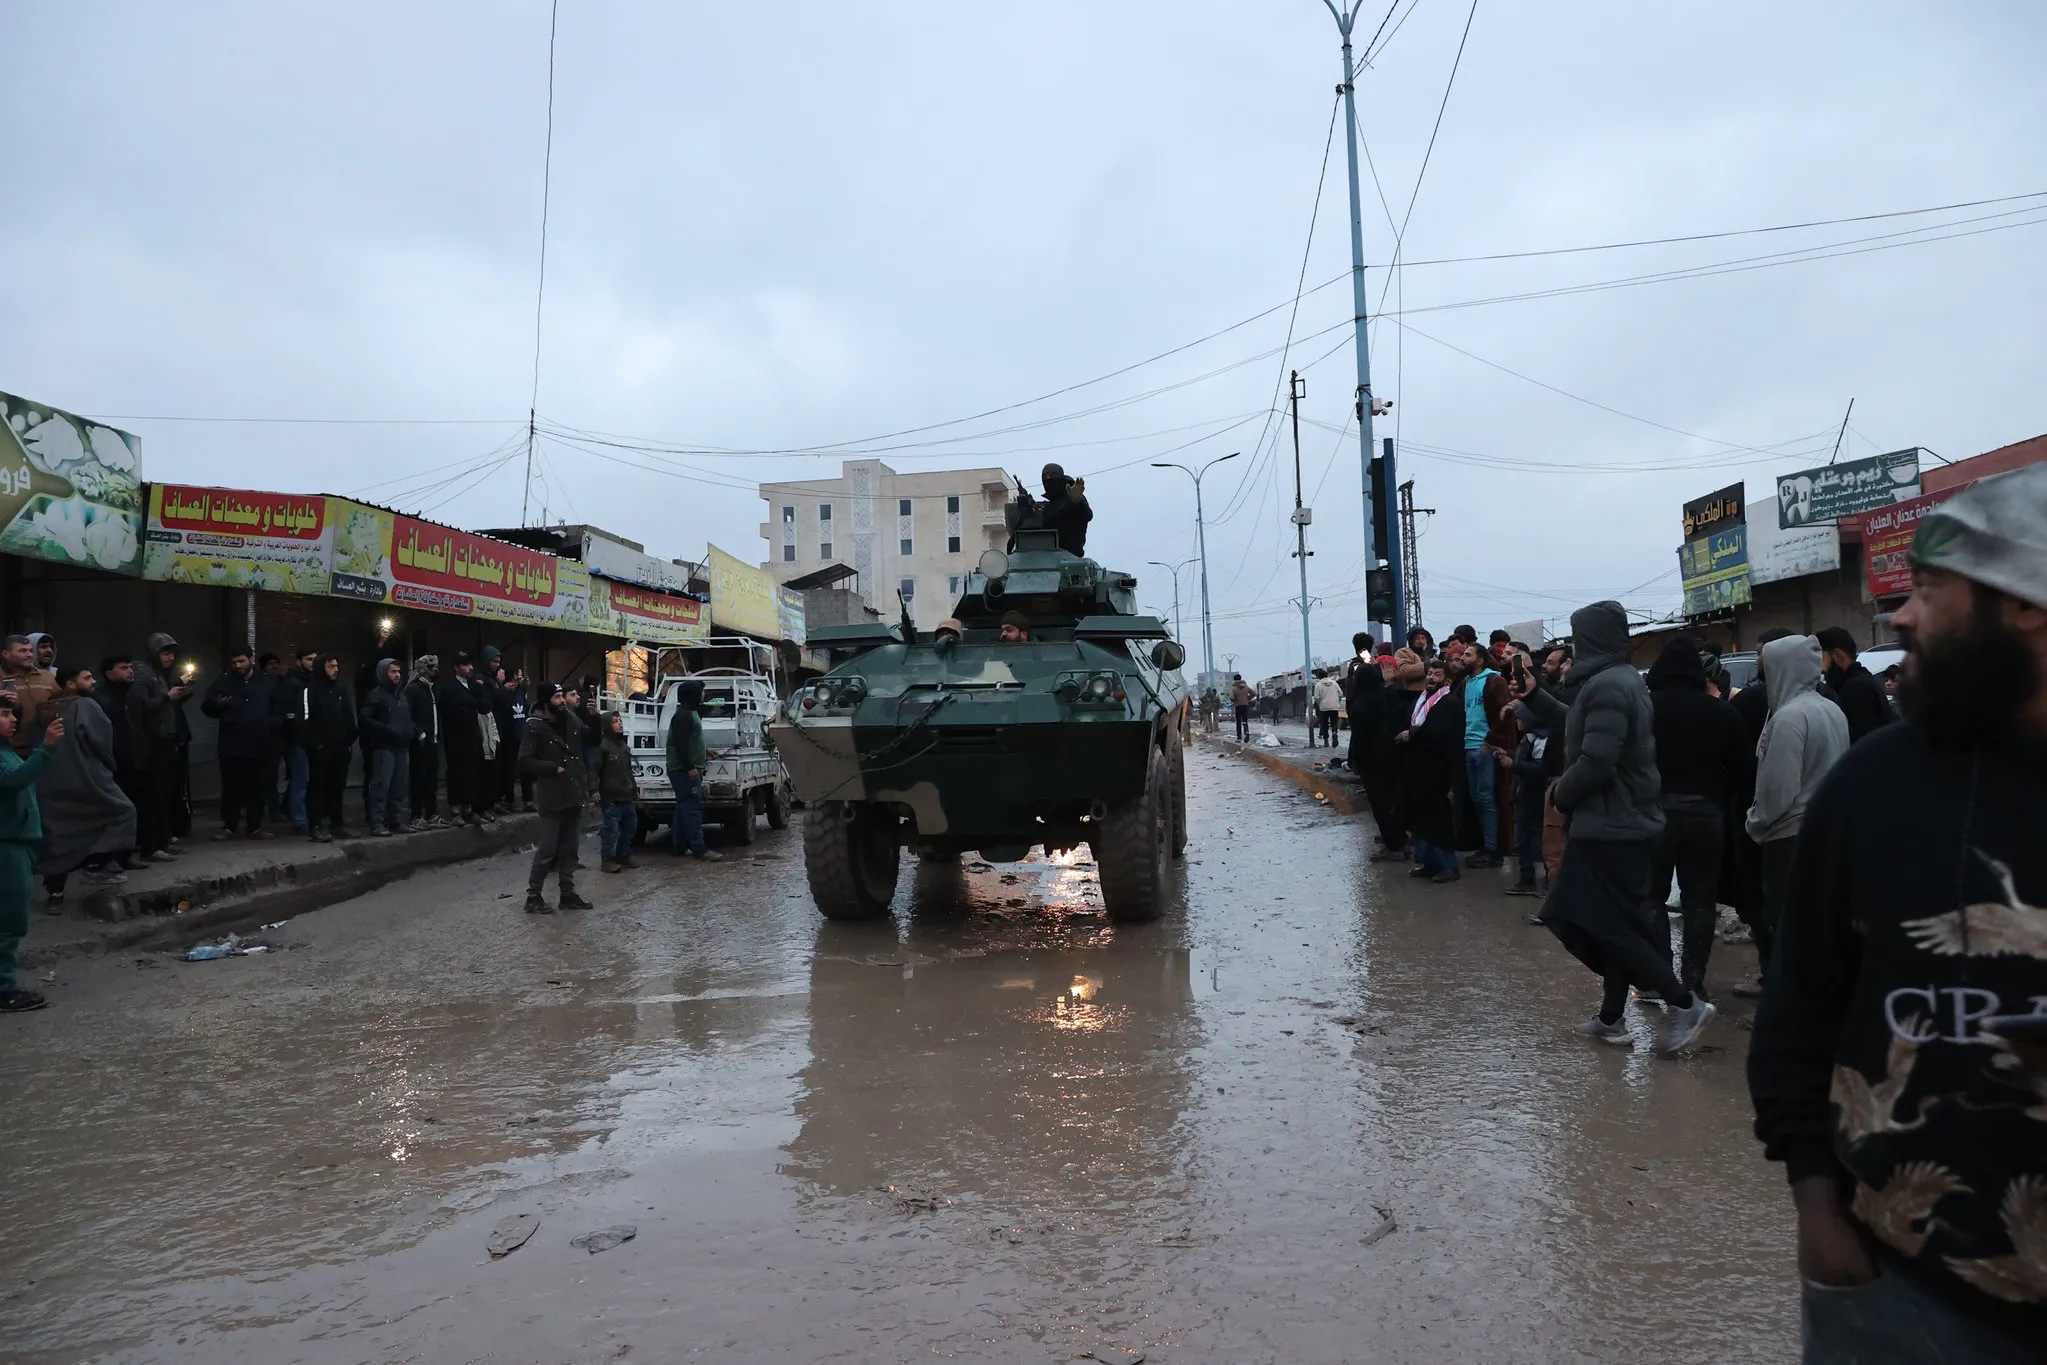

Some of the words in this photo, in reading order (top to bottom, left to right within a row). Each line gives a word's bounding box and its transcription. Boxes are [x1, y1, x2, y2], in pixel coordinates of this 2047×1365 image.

[1782, 485, 1791, 497] R
[1856, 466, 1882, 486] ريم
[164, 491, 210, 523] العساف
[211, 495, 261, 530] معجنات
[1800, 491, 1807, 503] J
[261, 504, 271, 533] و
[273, 501, 318, 535] حلويات
[1695, 499, 1724, 530] الملكي
[1866, 512, 1893, 536] العليان
[1893, 508, 1915, 529] عدنان
[398, 527, 453, 575] العساف
[454, 542, 504, 588] معجنات
[1711, 534, 1742, 569] الملكي
[505, 561, 513, 595] و
[515, 557, 553, 601] حلويات
[614, 588, 643, 609] العساف
